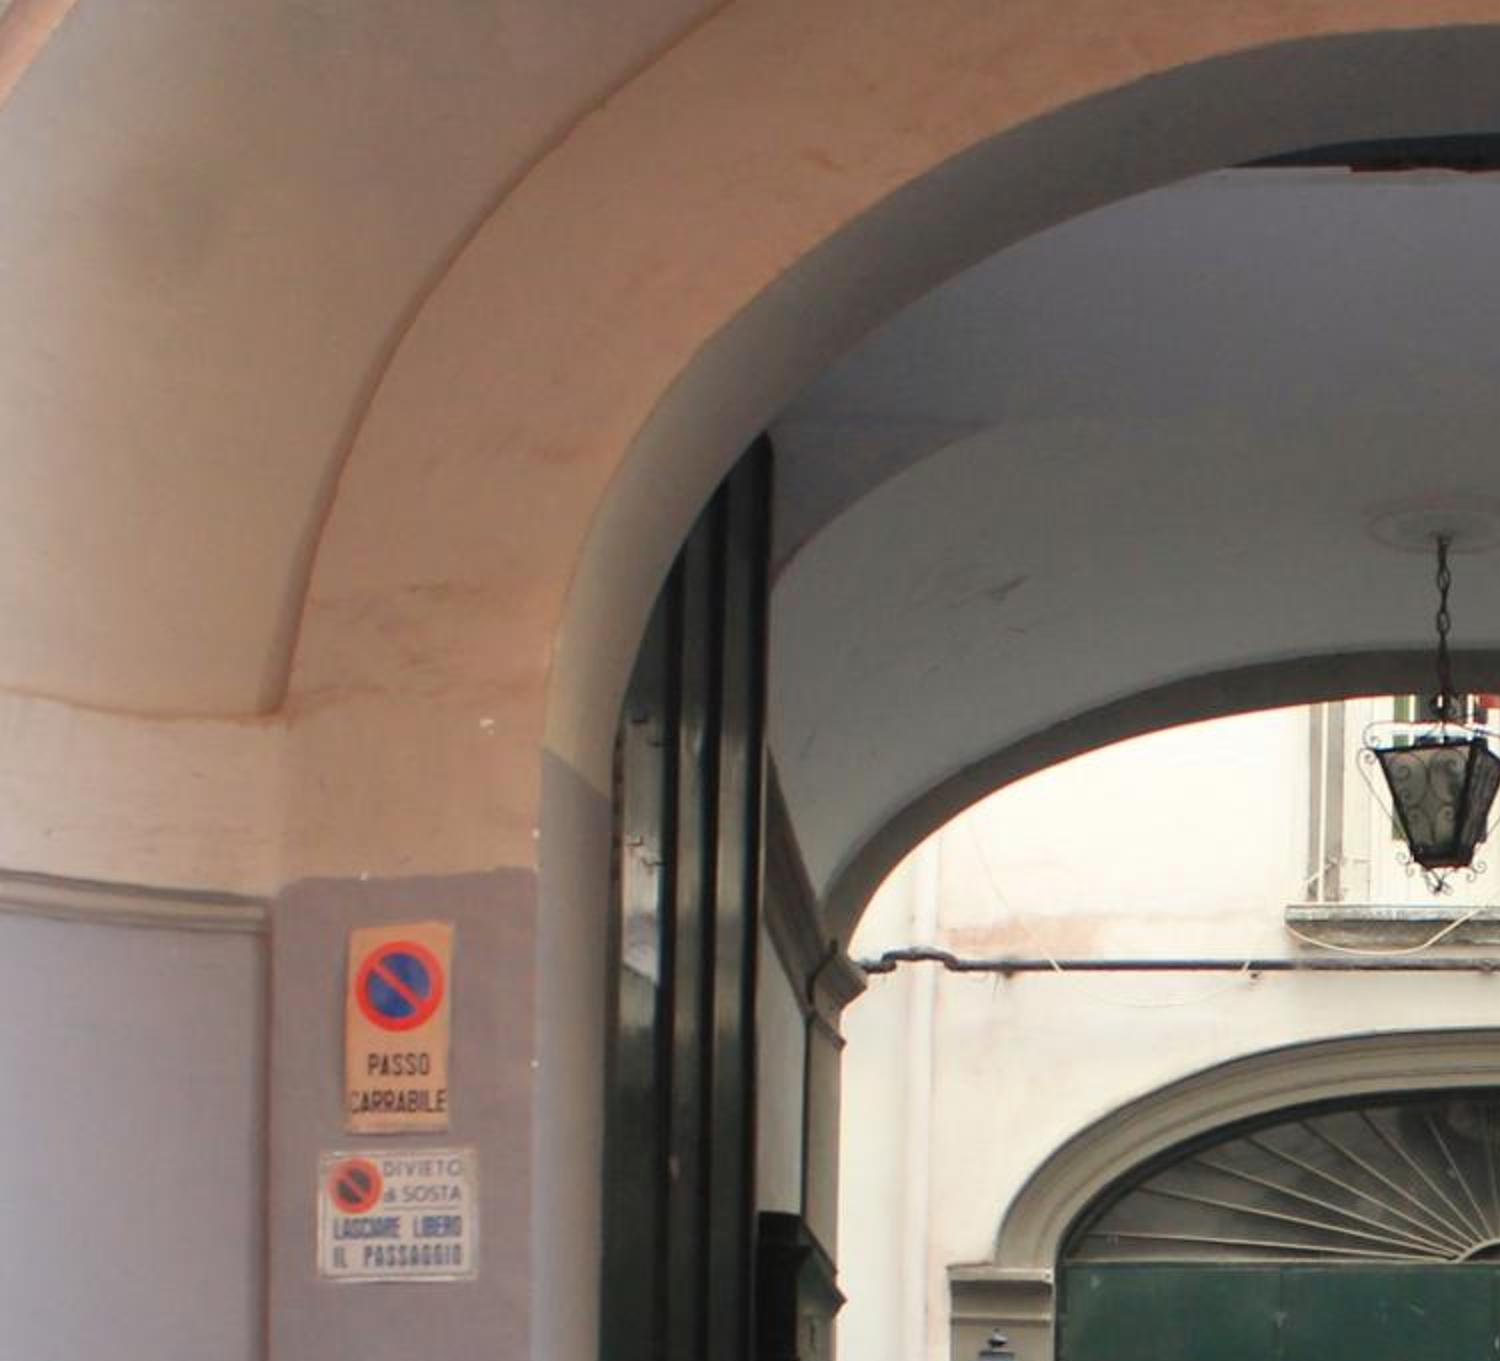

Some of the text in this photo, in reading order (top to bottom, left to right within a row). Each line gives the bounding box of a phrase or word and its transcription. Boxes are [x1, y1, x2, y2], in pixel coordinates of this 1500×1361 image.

[367, 1053, 431, 1076] PASSO
[383, 1159, 462, 1178] DIVIETO
[401, 1184, 462, 1203] SOSTA
[333, 1244, 462, 1268] IL PASSAGGIO
